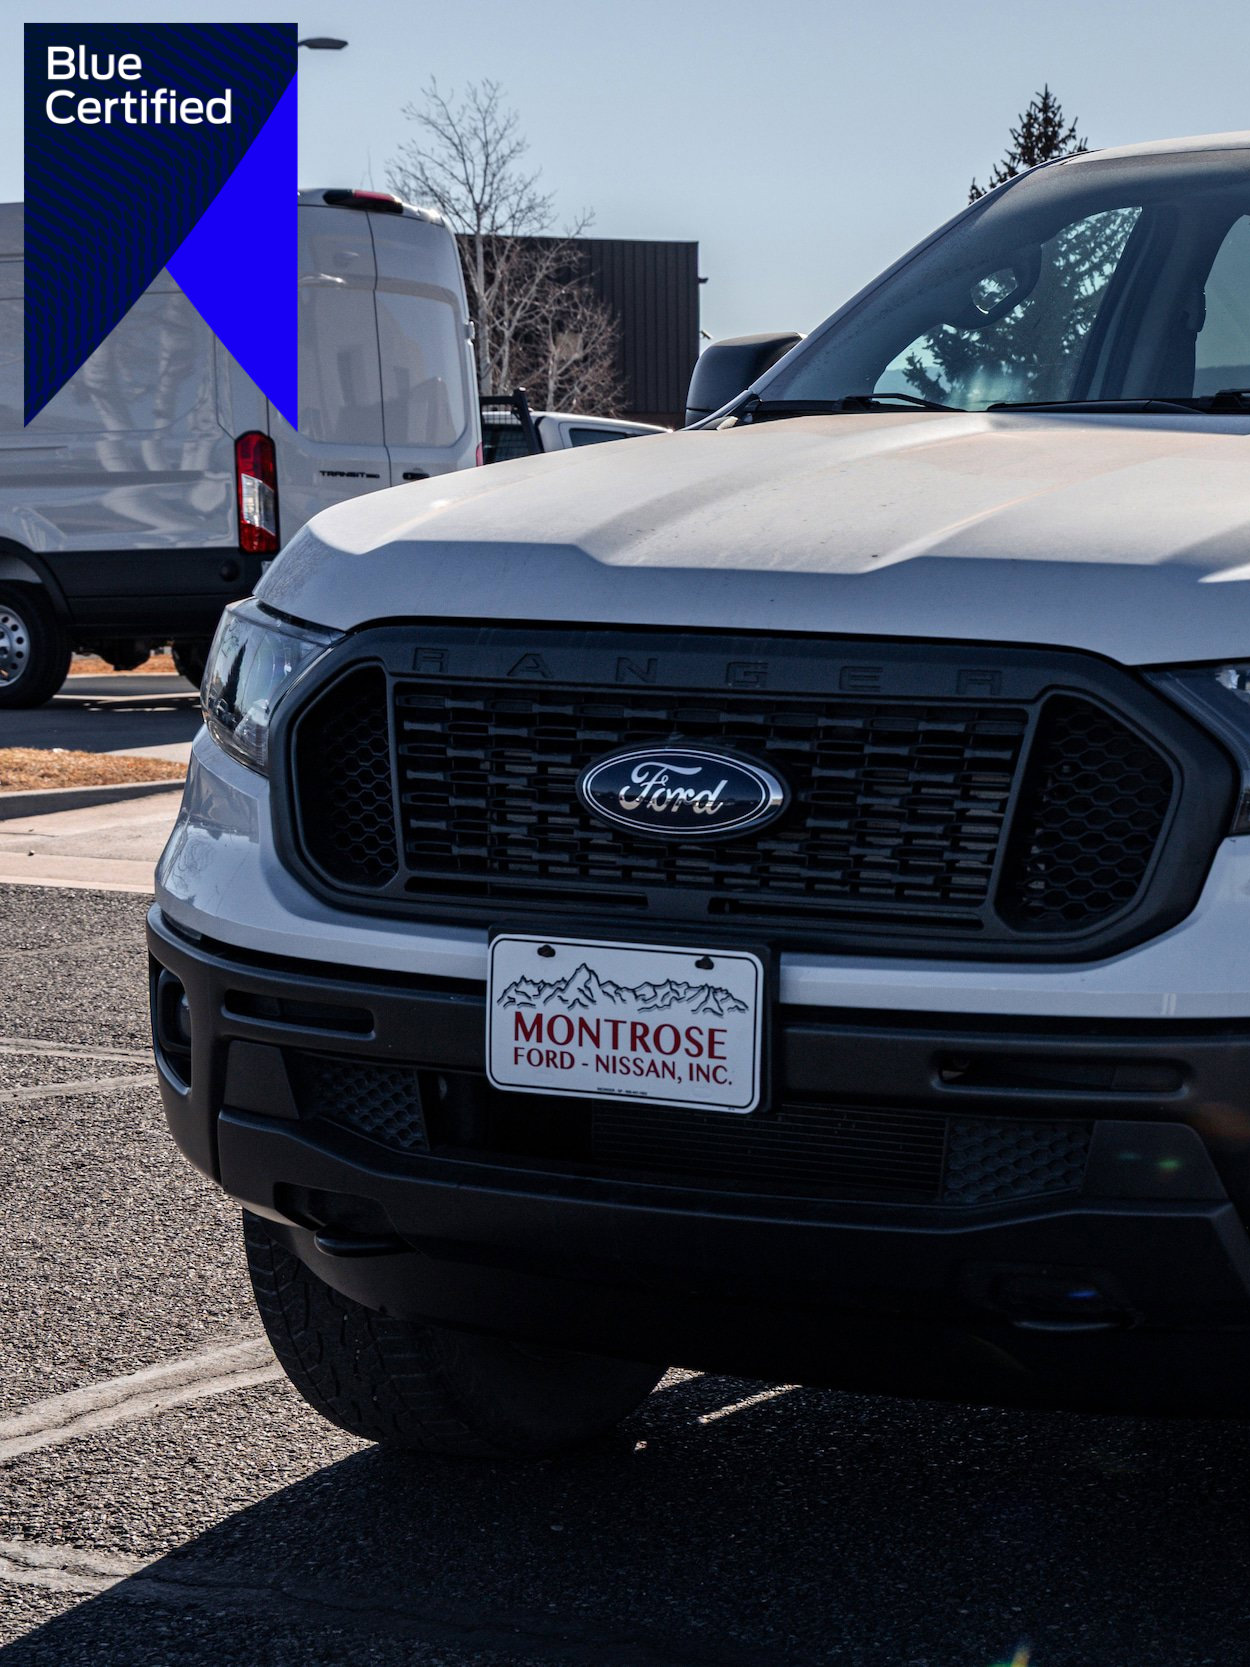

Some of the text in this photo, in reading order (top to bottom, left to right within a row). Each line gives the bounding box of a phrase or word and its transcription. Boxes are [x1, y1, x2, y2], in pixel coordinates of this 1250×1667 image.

[411, 647, 1003, 695] RANGER
[618, 761, 729, 816] Ford
[513, 1011, 728, 1061] MONTROSE
[513, 1046, 575, 1070] FORD
[595, 1054, 682, 1085] NISSAN,
[688, 1062, 733, 1086] INC.
